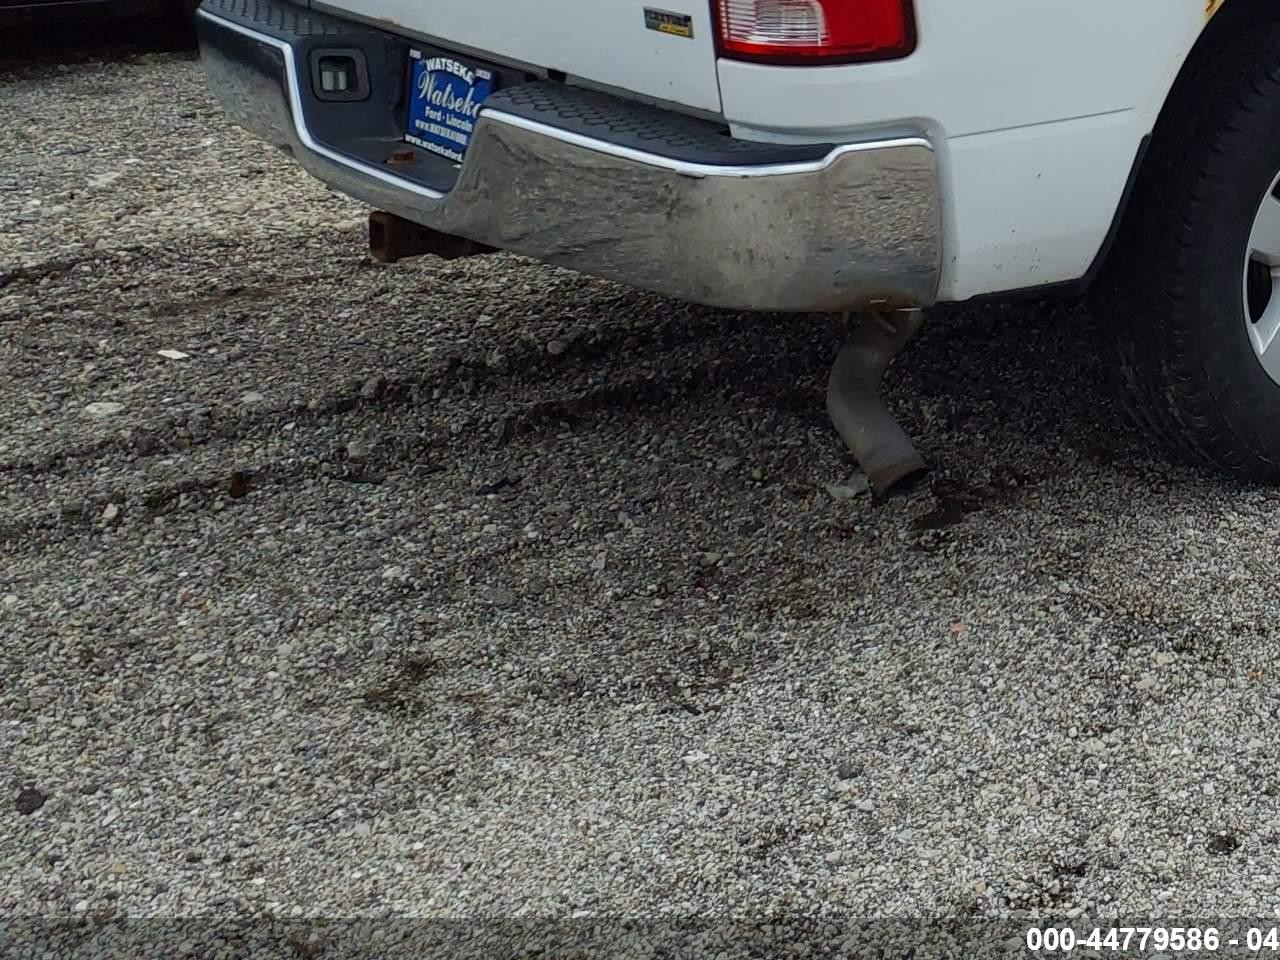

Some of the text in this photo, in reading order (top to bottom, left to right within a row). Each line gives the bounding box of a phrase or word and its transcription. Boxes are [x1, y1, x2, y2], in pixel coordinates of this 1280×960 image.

[425, 57, 475, 85] WATSEKA
[425, 105, 442, 122] Ford
[446, 113, 473, 133] Lincoln
